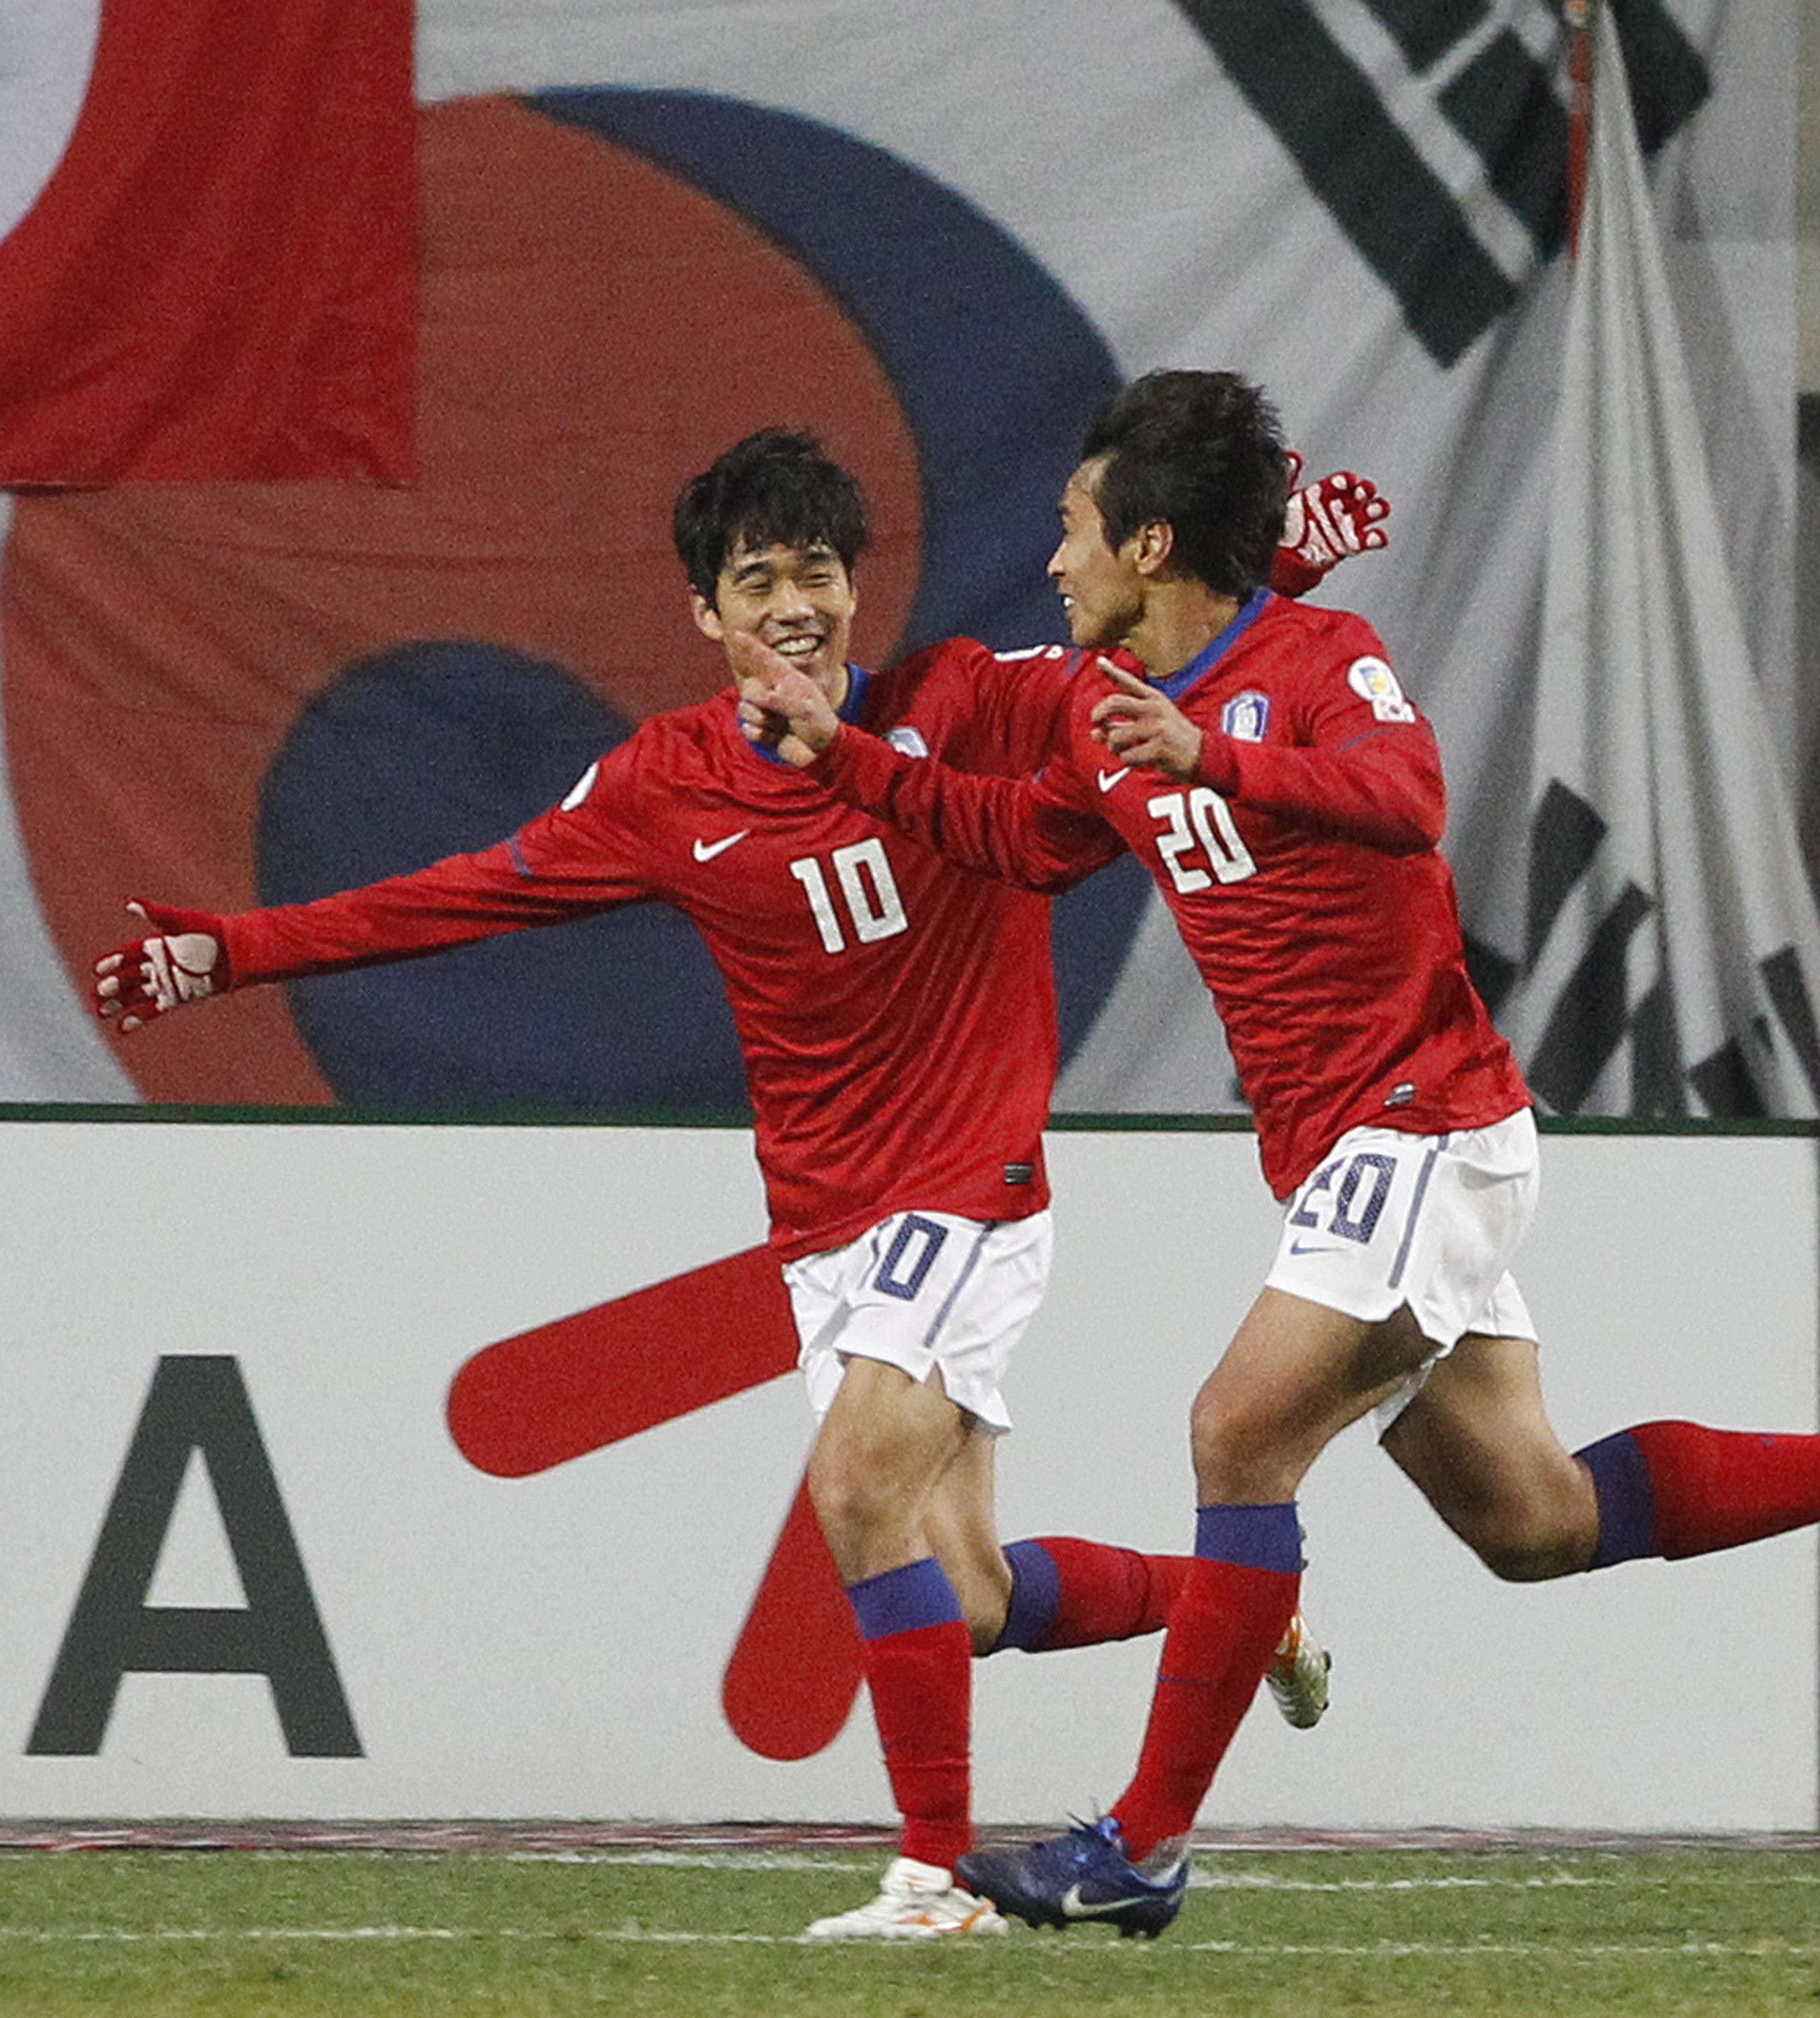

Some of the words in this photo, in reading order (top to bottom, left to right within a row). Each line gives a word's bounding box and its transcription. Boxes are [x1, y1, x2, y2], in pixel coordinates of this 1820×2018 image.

[790, 837, 909, 953] 10
[1147, 787, 1258, 894] 20
[24, 1355, 367, 1758] A
